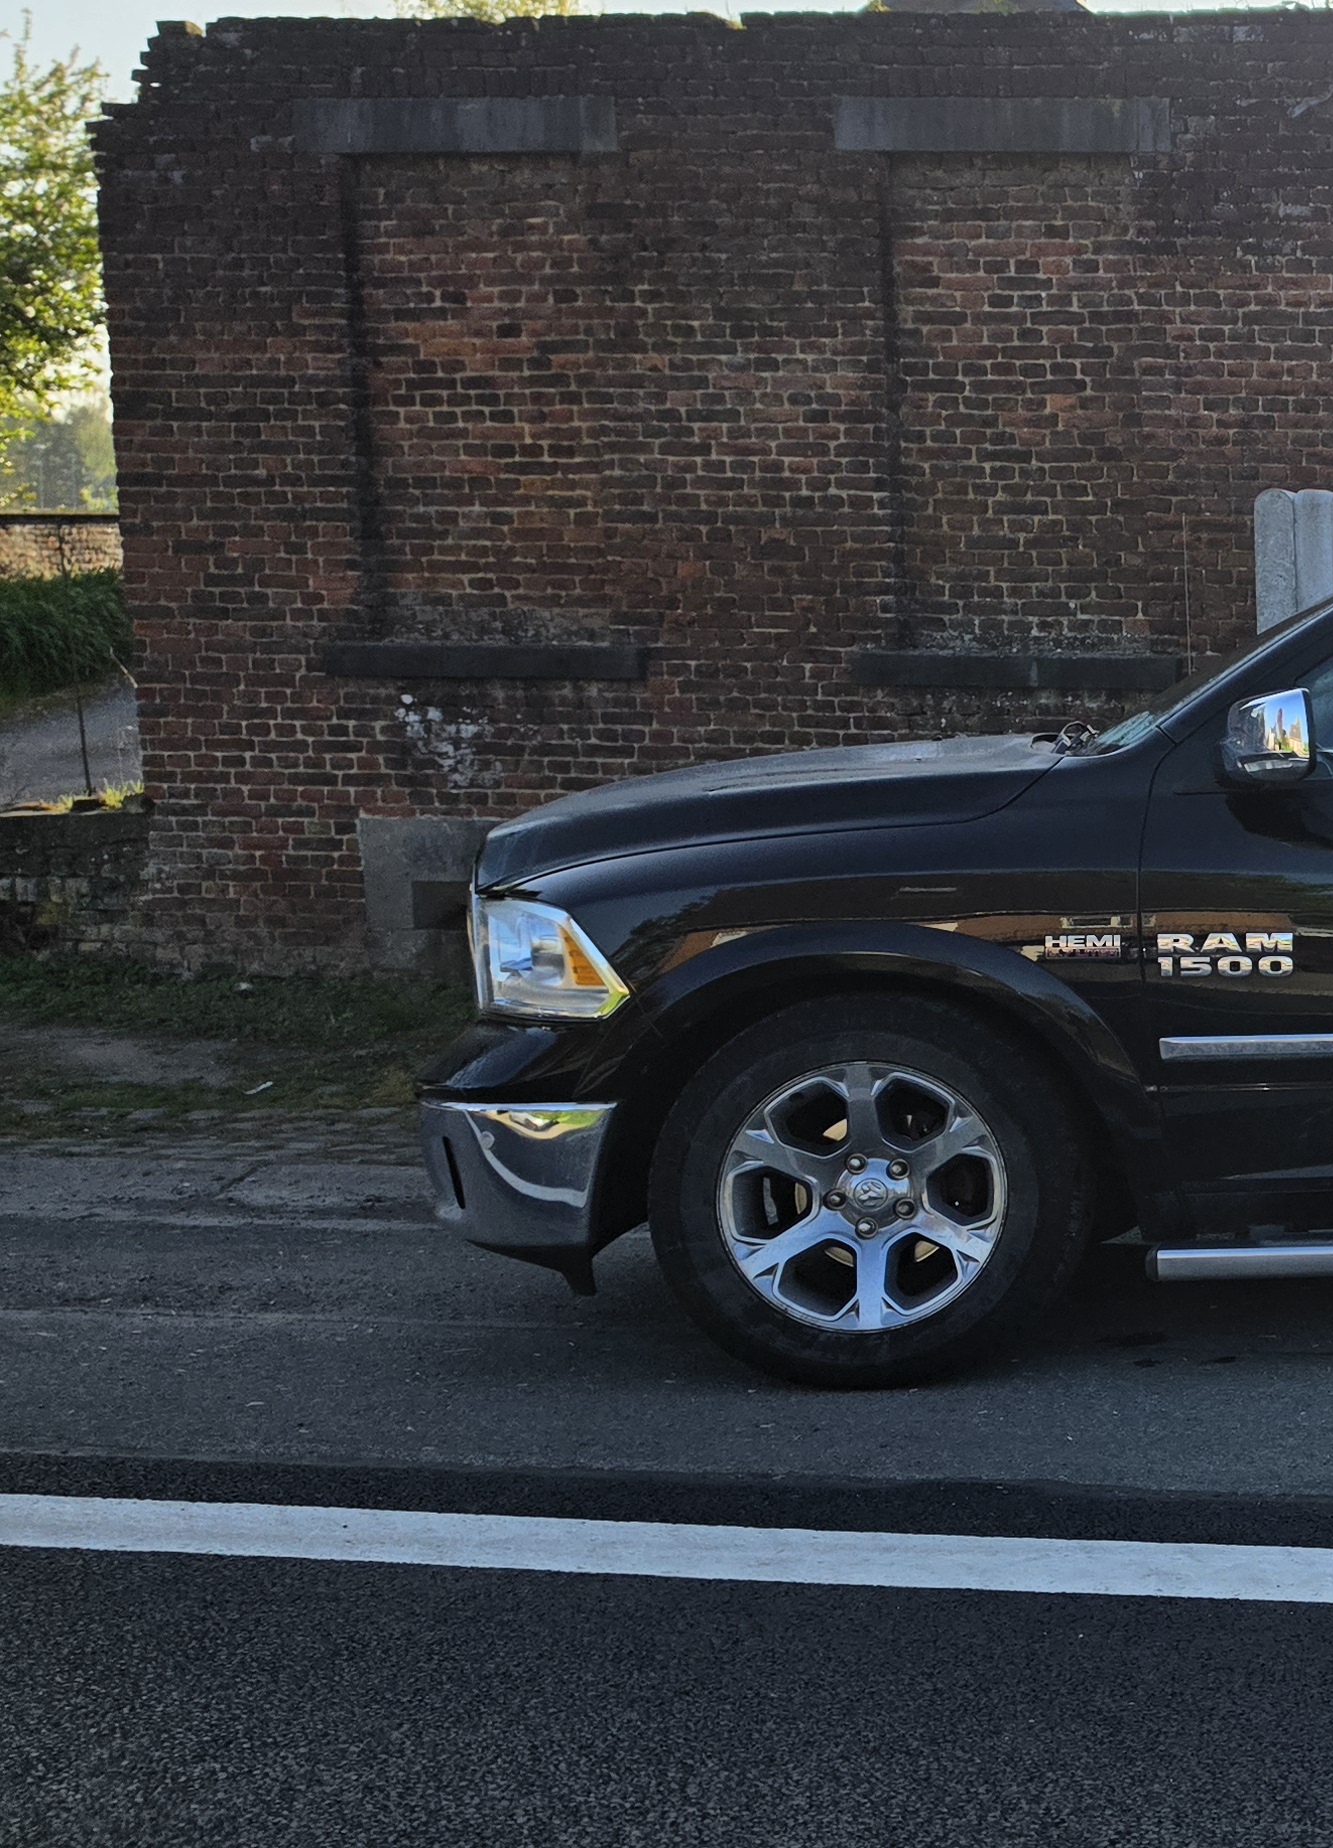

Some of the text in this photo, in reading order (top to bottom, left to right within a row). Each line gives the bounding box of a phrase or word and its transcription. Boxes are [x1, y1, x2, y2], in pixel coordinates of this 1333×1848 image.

[1045, 935, 1120, 948] HEMI
[1157, 932, 1293, 953] RAM
[1157, 956, 1293, 977] 1500
